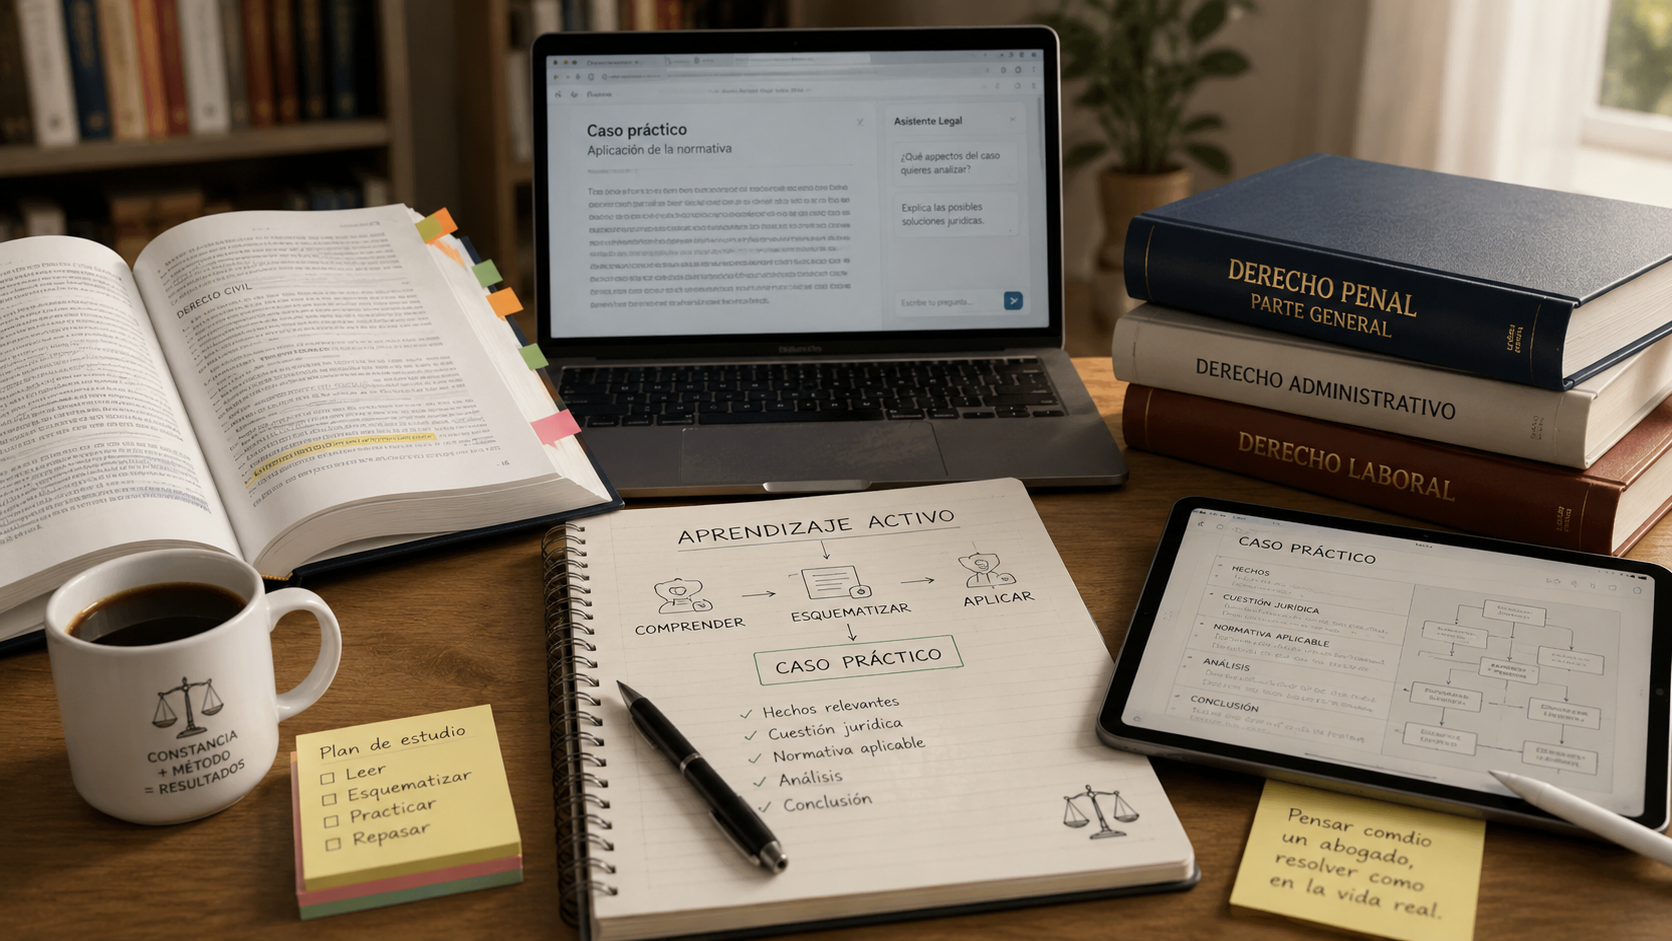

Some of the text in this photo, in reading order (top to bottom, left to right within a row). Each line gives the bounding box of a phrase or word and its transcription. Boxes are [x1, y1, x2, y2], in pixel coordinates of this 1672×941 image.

[587, 122, 688, 141] Caso práctico
[894, 116, 963, 127] Asistente Legal
[587, 143, 733, 158] Aplicación de la normativa
[900, 152, 923, 163] ¿Qué
[965, 151, 979, 160] del
[980, 151, 1001, 160] caso
[900, 164, 972, 176] quieres analizar?
[901, 202, 984, 214] Explica las posibles
[901, 216, 946, 226] soluciones
[223, 282, 253, 296] CIVIL
[1228, 257, 1418, 318] DERECHO PENAL
[1250, 293, 1393, 339] PARTE GENERAL
[1195, 358, 1457, 421] DERECHO ADMINISTRATIVO
[1237, 431, 1456, 503] DERECHO LABORAL
[677, 508, 956, 546] APRENDIZAJE ACTIVO
[1238, 535, 1378, 566] CASO PRÁCTICO
[1231, 564, 1271, 578] HECHOS
[963, 590, 1036, 608] APLICAR
[1222, 592, 1320, 616] CUESTIÓN JURÍDICA
[790, 602, 912, 624] ESQUEMATIZAR
[634, 616, 746, 637] COMPRENDER
[1213, 622, 1273, 640] NORMATIVA
[1275, 632, 1331, 649] APLICABLE
[775, 647, 943, 676] CASO PRÁCTICO
[1202, 656, 1252, 673] ANÁLISIS
[762, 696, 901, 719] Hechos relevantes
[1190, 694, 1260, 714] CONCLUSIÓN
[768, 717, 904, 741] Cuestión jurídica
[147, 730, 239, 764] CONSTANCIA
[319, 725, 467, 760] Plan de estudio
[773, 736, 927, 763] Normativa aplicable
[172, 750, 231, 777] MÉTODO
[346, 765, 387, 781] Leer
[159, 758, 246, 795] RESULTADOS
[348, 771, 473, 802] Esquematizar
[779, 770, 844, 787] Análisis
[350, 799, 437, 824] Practicar
[783, 792, 873, 813] Conclusión
[1288, 807, 1355, 833] Pensar
[353, 823, 431, 847] Repasar
[1282, 833, 1414, 871] un abogado,
[1275, 853, 1425, 893] resolver como
[1269, 876, 1443, 921] en la vida real.
